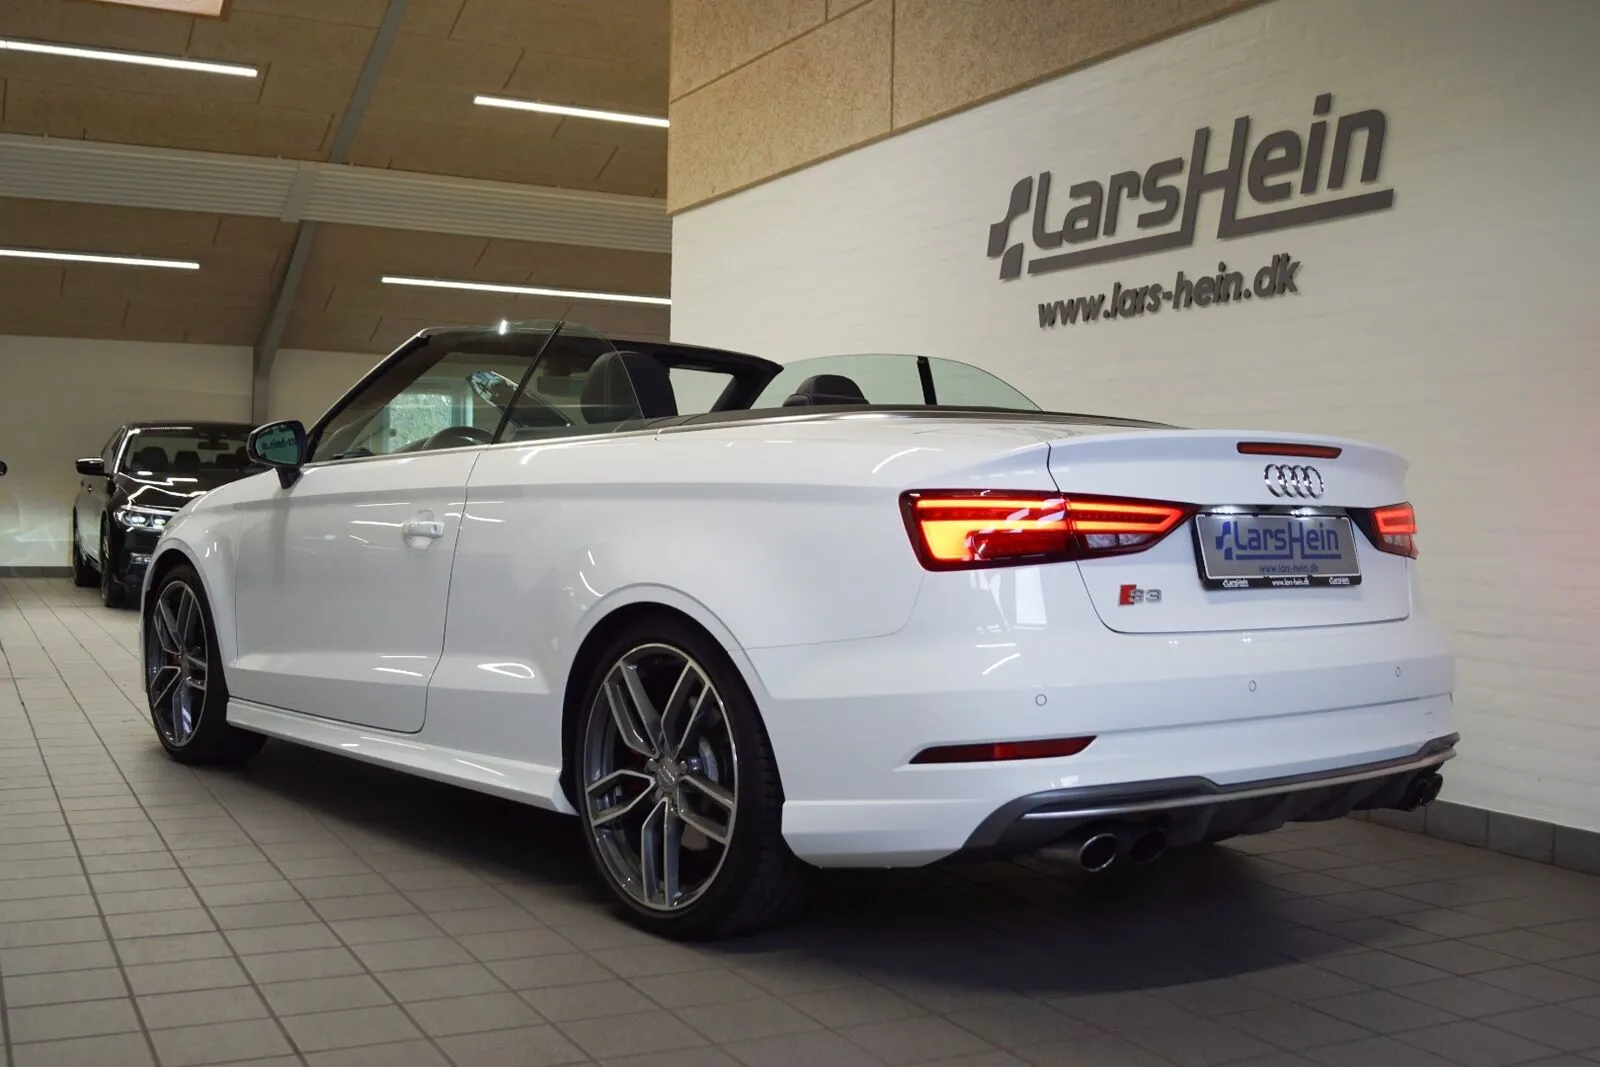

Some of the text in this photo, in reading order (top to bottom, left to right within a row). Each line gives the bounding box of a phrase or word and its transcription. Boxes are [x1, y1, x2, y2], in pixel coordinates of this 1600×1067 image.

[1028, 92, 1394, 274] LarsHein
[1038, 252, 1301, 328] www.lars-hein.dk
[1233, 520, 1342, 560] LarsHein
[1129, 588, 1162, 603] S3
